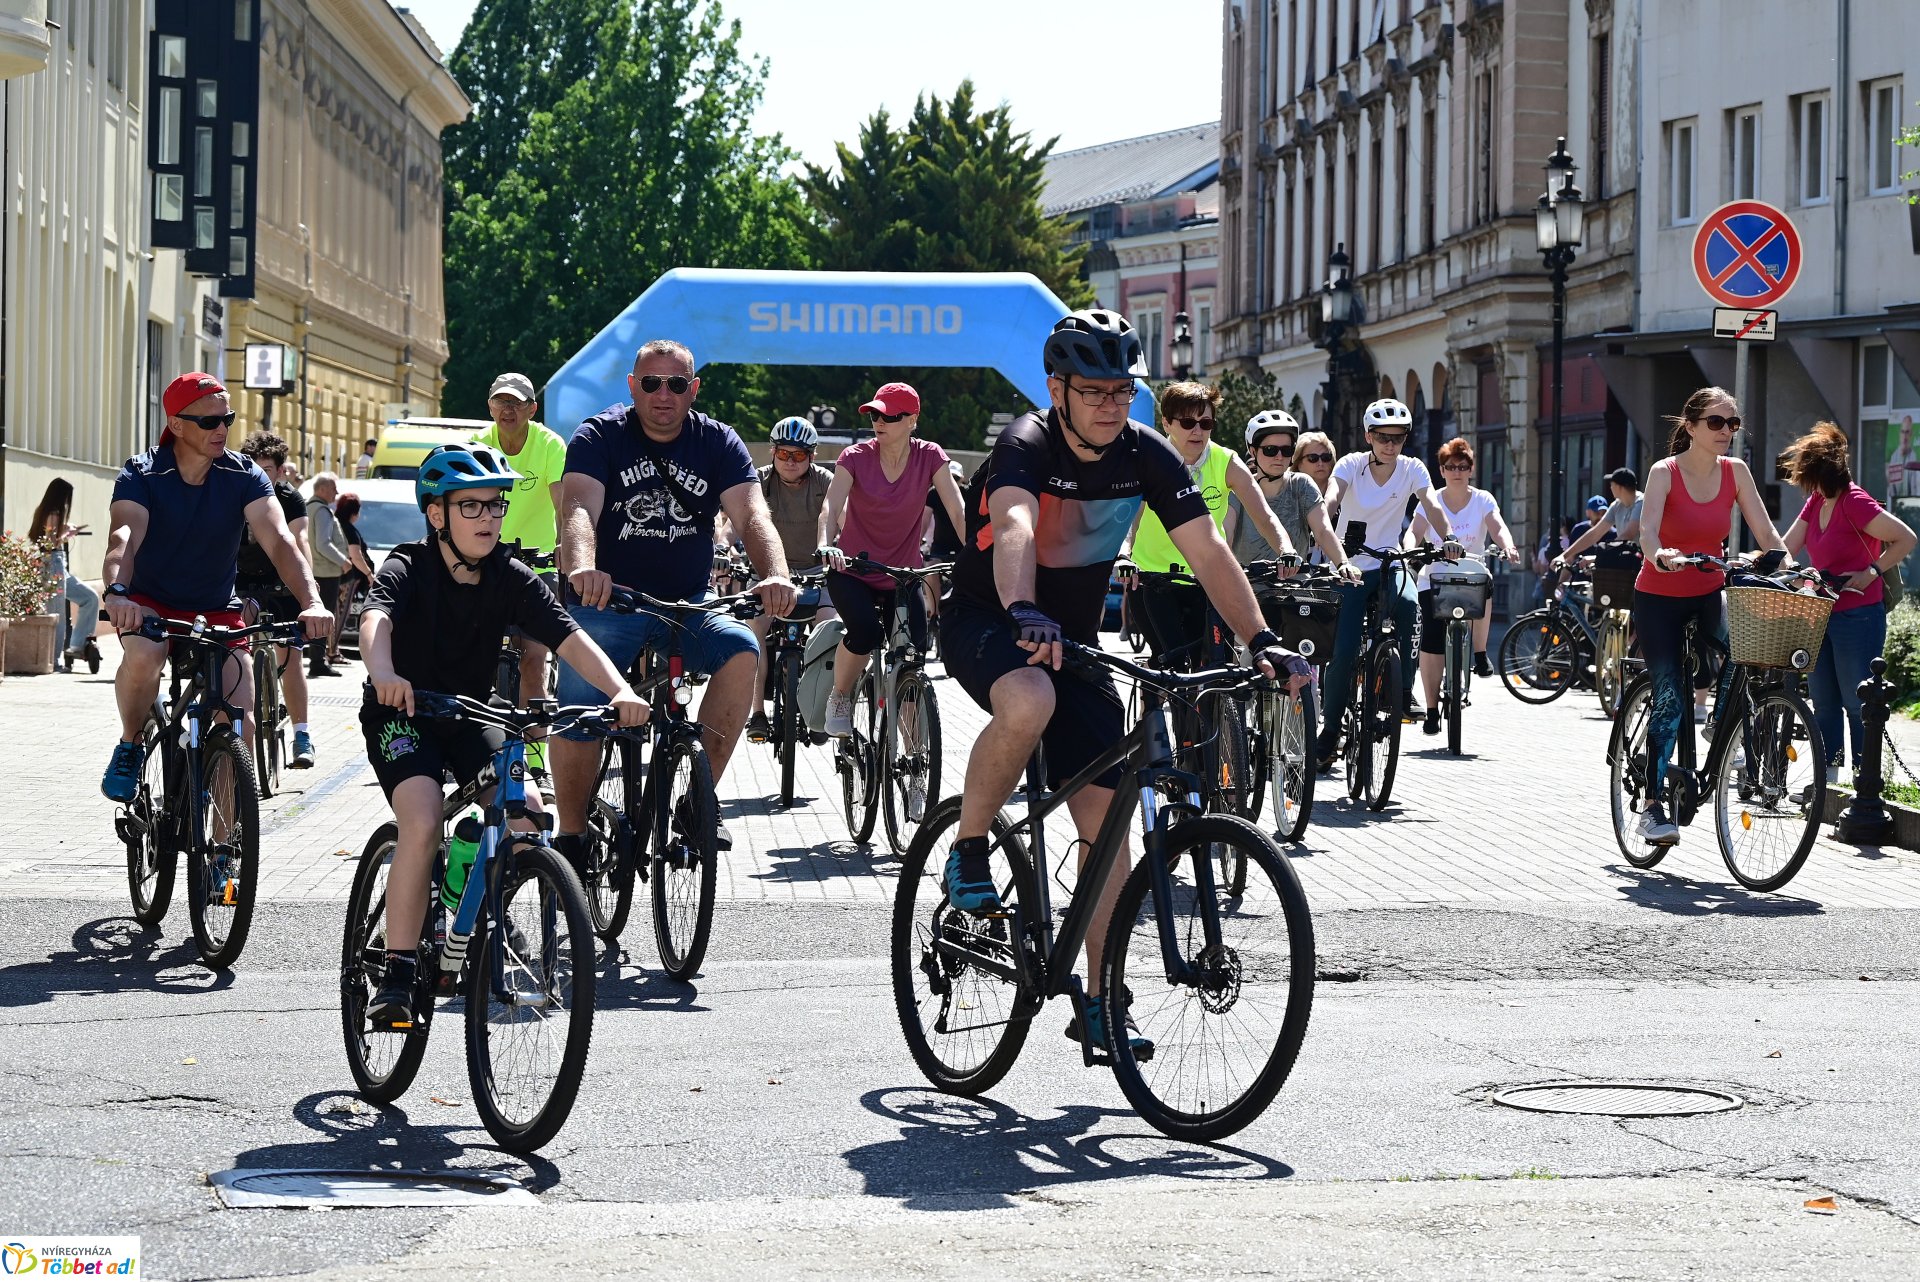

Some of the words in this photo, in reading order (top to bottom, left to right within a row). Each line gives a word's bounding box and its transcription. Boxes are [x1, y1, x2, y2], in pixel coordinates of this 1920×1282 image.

[749, 302, 963, 334] SHIMANO
[661, 461, 708, 497] PEED
[1048, 476, 1078, 490] CUBE
[1410, 603, 1422, 660] adidas
[1105, 963, 1121, 1062] SCHWALBE
